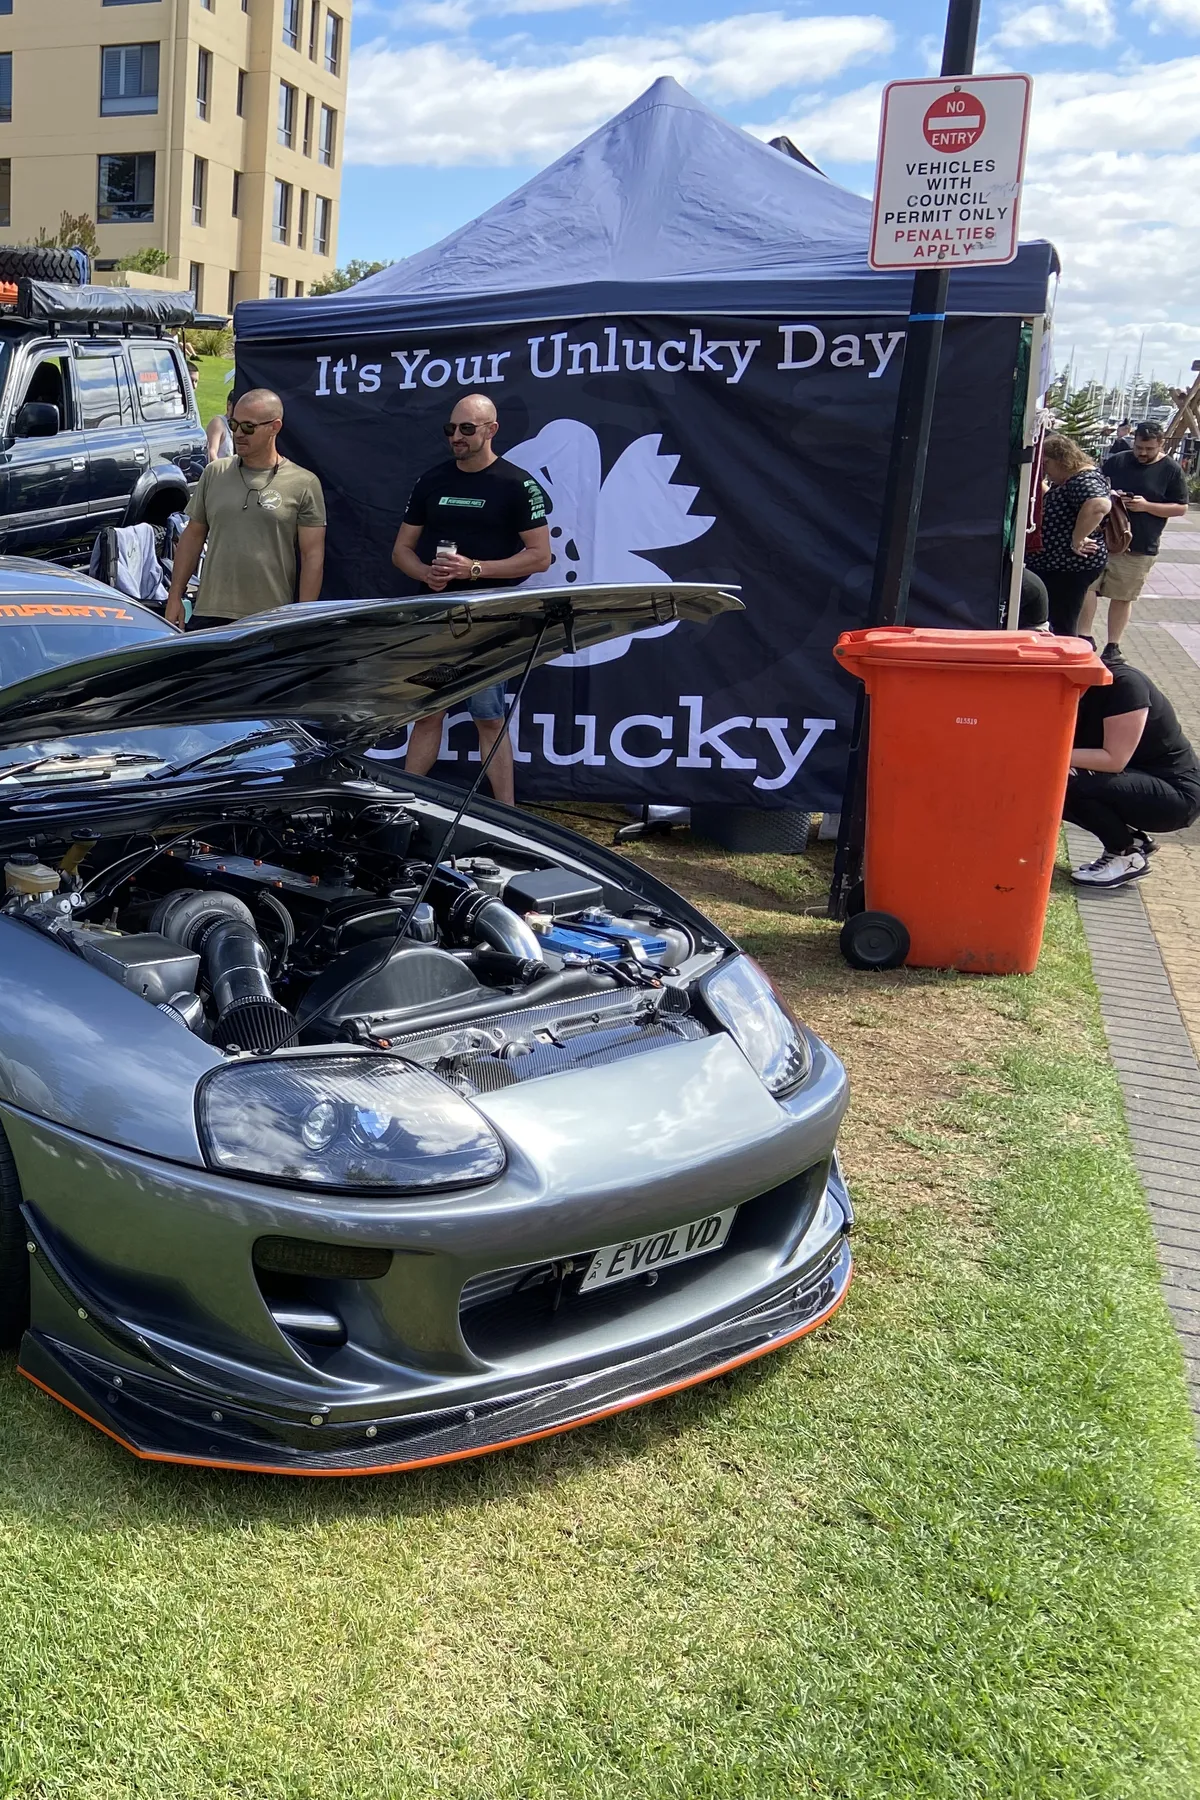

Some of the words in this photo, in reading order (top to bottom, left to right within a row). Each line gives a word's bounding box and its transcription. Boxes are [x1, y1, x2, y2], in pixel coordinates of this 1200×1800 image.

[946, 100, 966, 113] NO
[932, 131, 977, 146] ENTRY
[905, 159, 996, 176] VEHICLES
[926, 177, 972, 190] WITH
[906, 192, 988, 208] COUNCIL
[884, 209, 952, 225] PERMIT
[959, 207, 1008, 222] ONLY
[894, 226, 996, 243] PENALTIES
[913, 243, 973, 258] APPLY
[314, 354, 382, 397] It's
[391, 348, 512, 391] Your
[527, 327, 762, 385] Unlucky
[777, 323, 907, 379] Day
[605, 1215, 722, 1279] EVOLVD
